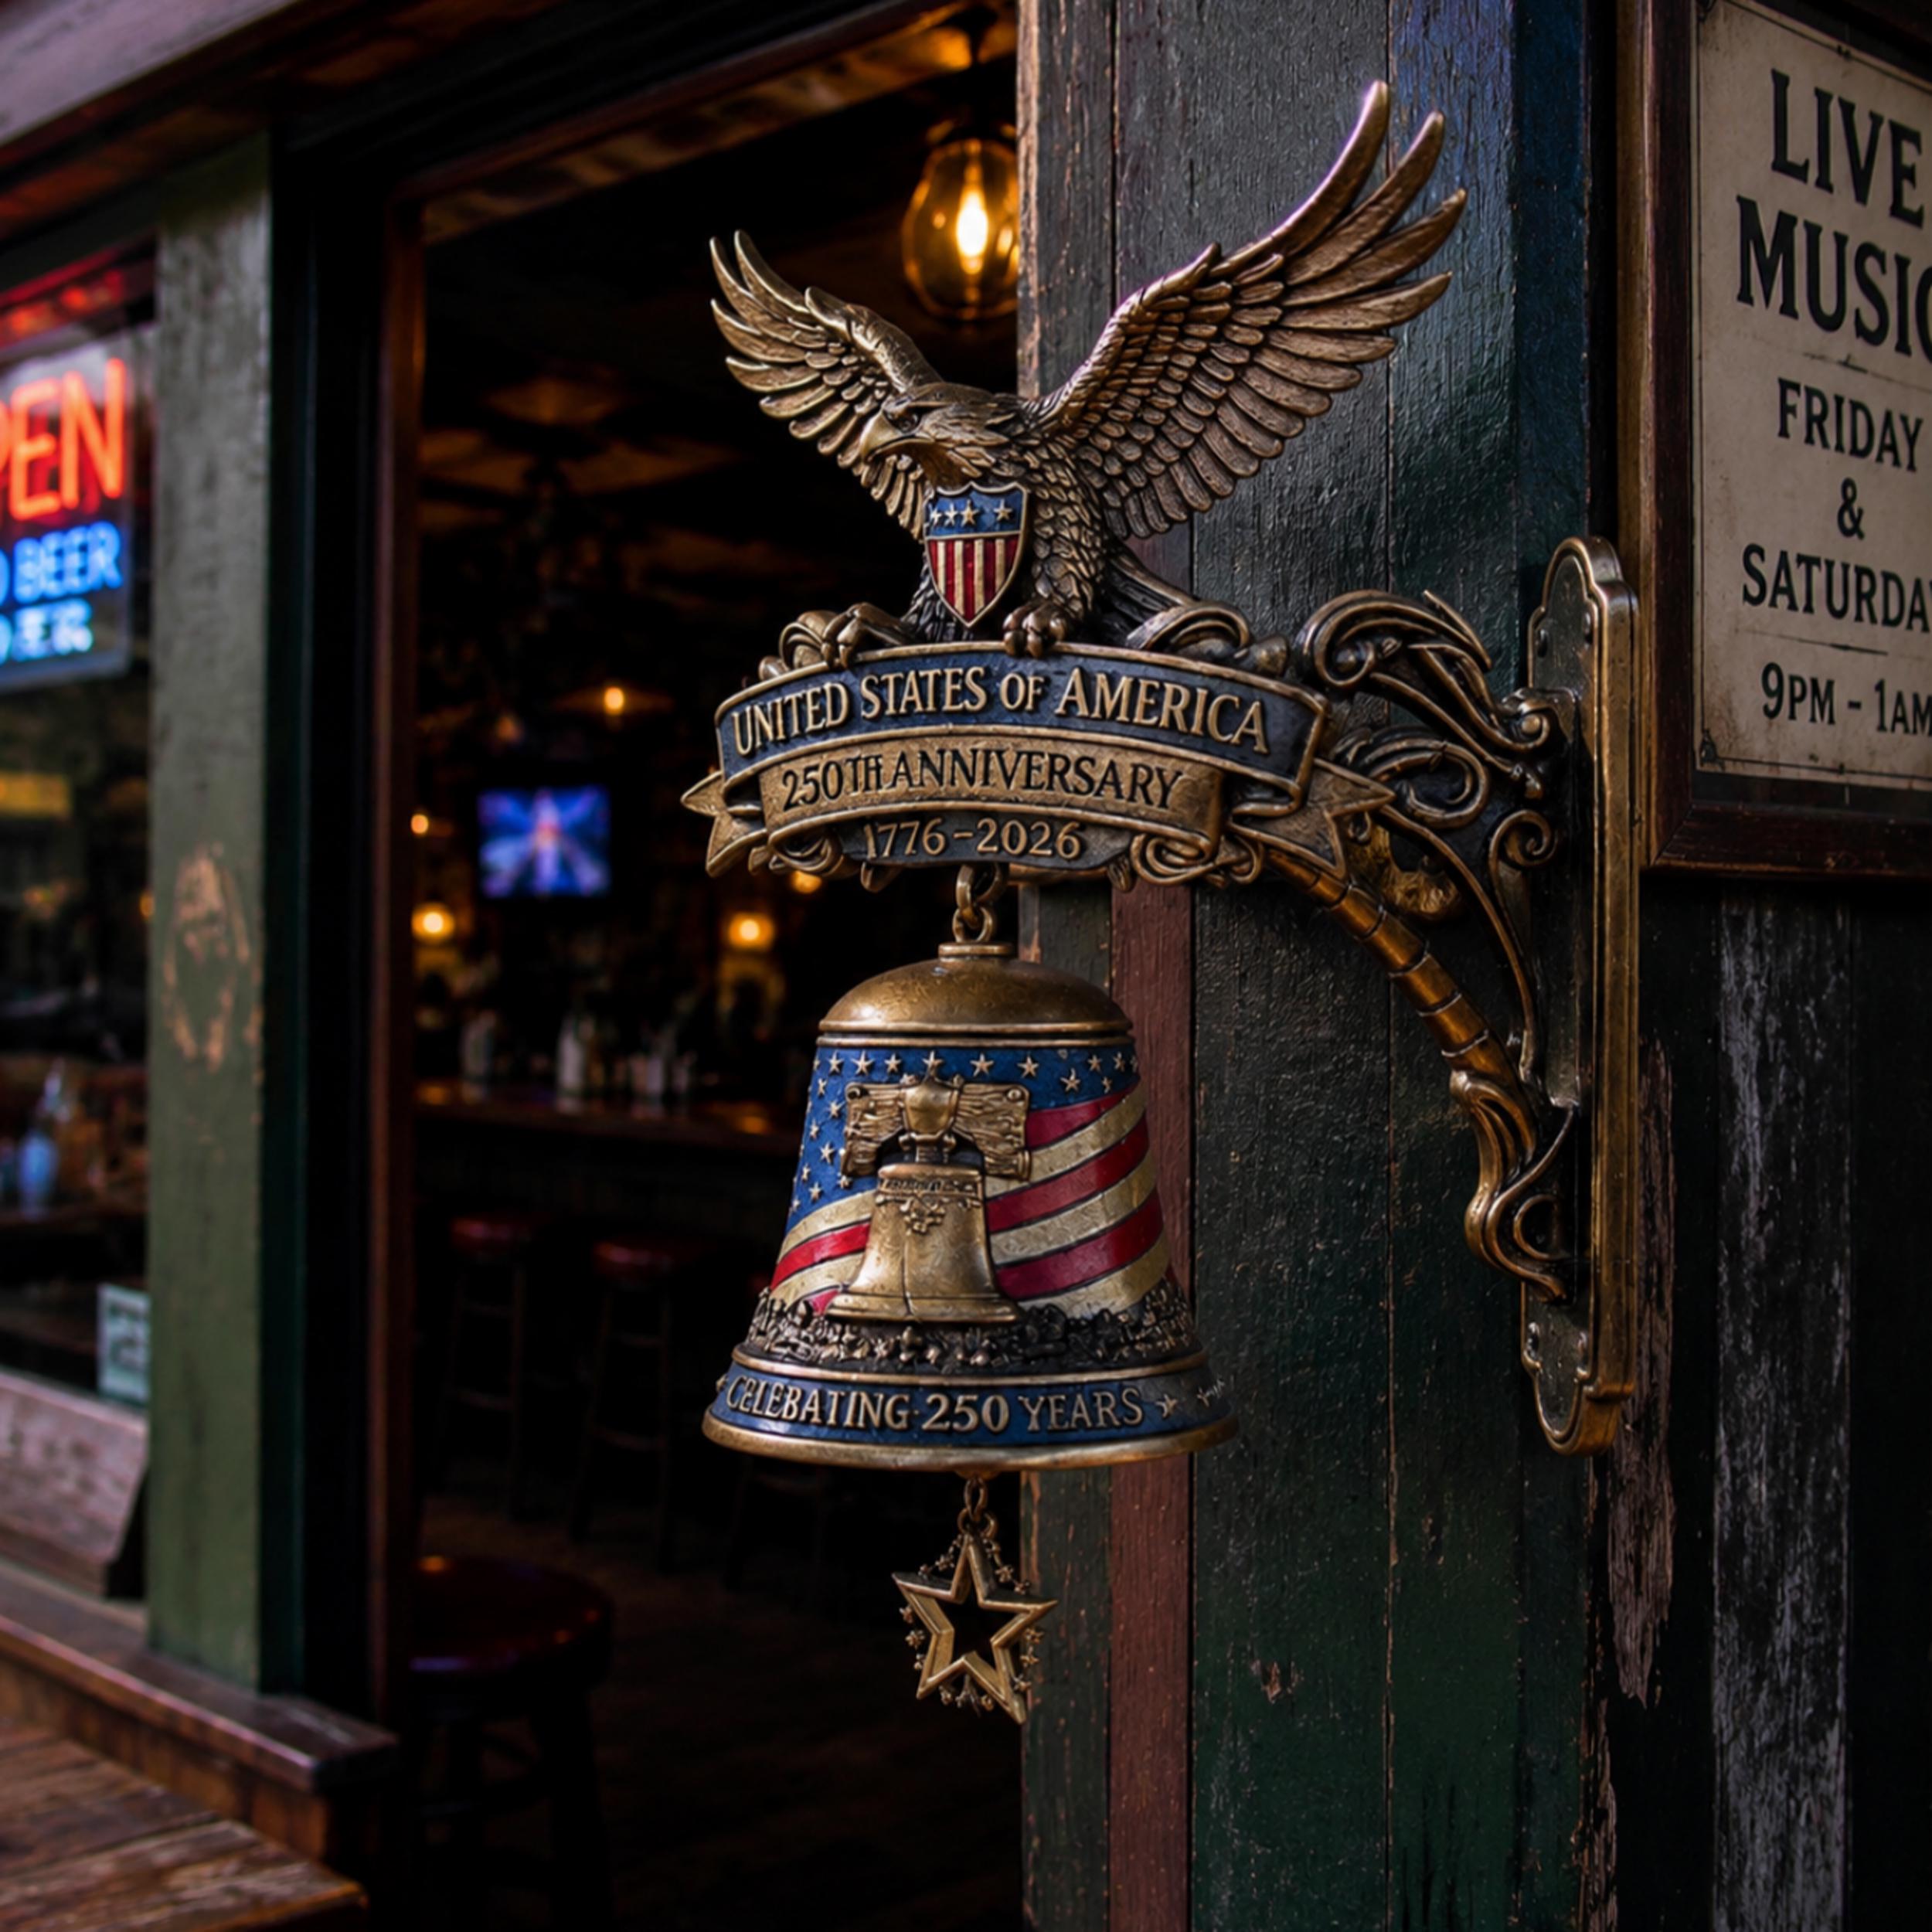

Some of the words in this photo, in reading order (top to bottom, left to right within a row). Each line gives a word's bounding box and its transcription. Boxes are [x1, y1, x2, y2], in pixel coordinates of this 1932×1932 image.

[1770, 68, 1925, 230] LIVE
[0, 357, 127, 521] EN
[1777, 377, 1923, 473] FRIDAY
[1837, 478, 1865, 540] &
[13, 521, 124, 604] BEER
[1742, 543, 1932, 634] SATURDA
[731, 682, 849, 757] UNITED
[860, 666, 988, 719] STATES
[999, 672, 1046, 711] OF
[1055, 667, 1270, 754] AMERICA
[1761, 662, 1835, 726] 9PM
[1874, 679, 1932, 739] 1AM
[781, 753, 883, 811] 250TH
[889, 748, 1183, 809] ANNIVERSARY
[921, 1393, 1010, 1433] 250
[1018, 1387, 1144, 1432] YEARS
